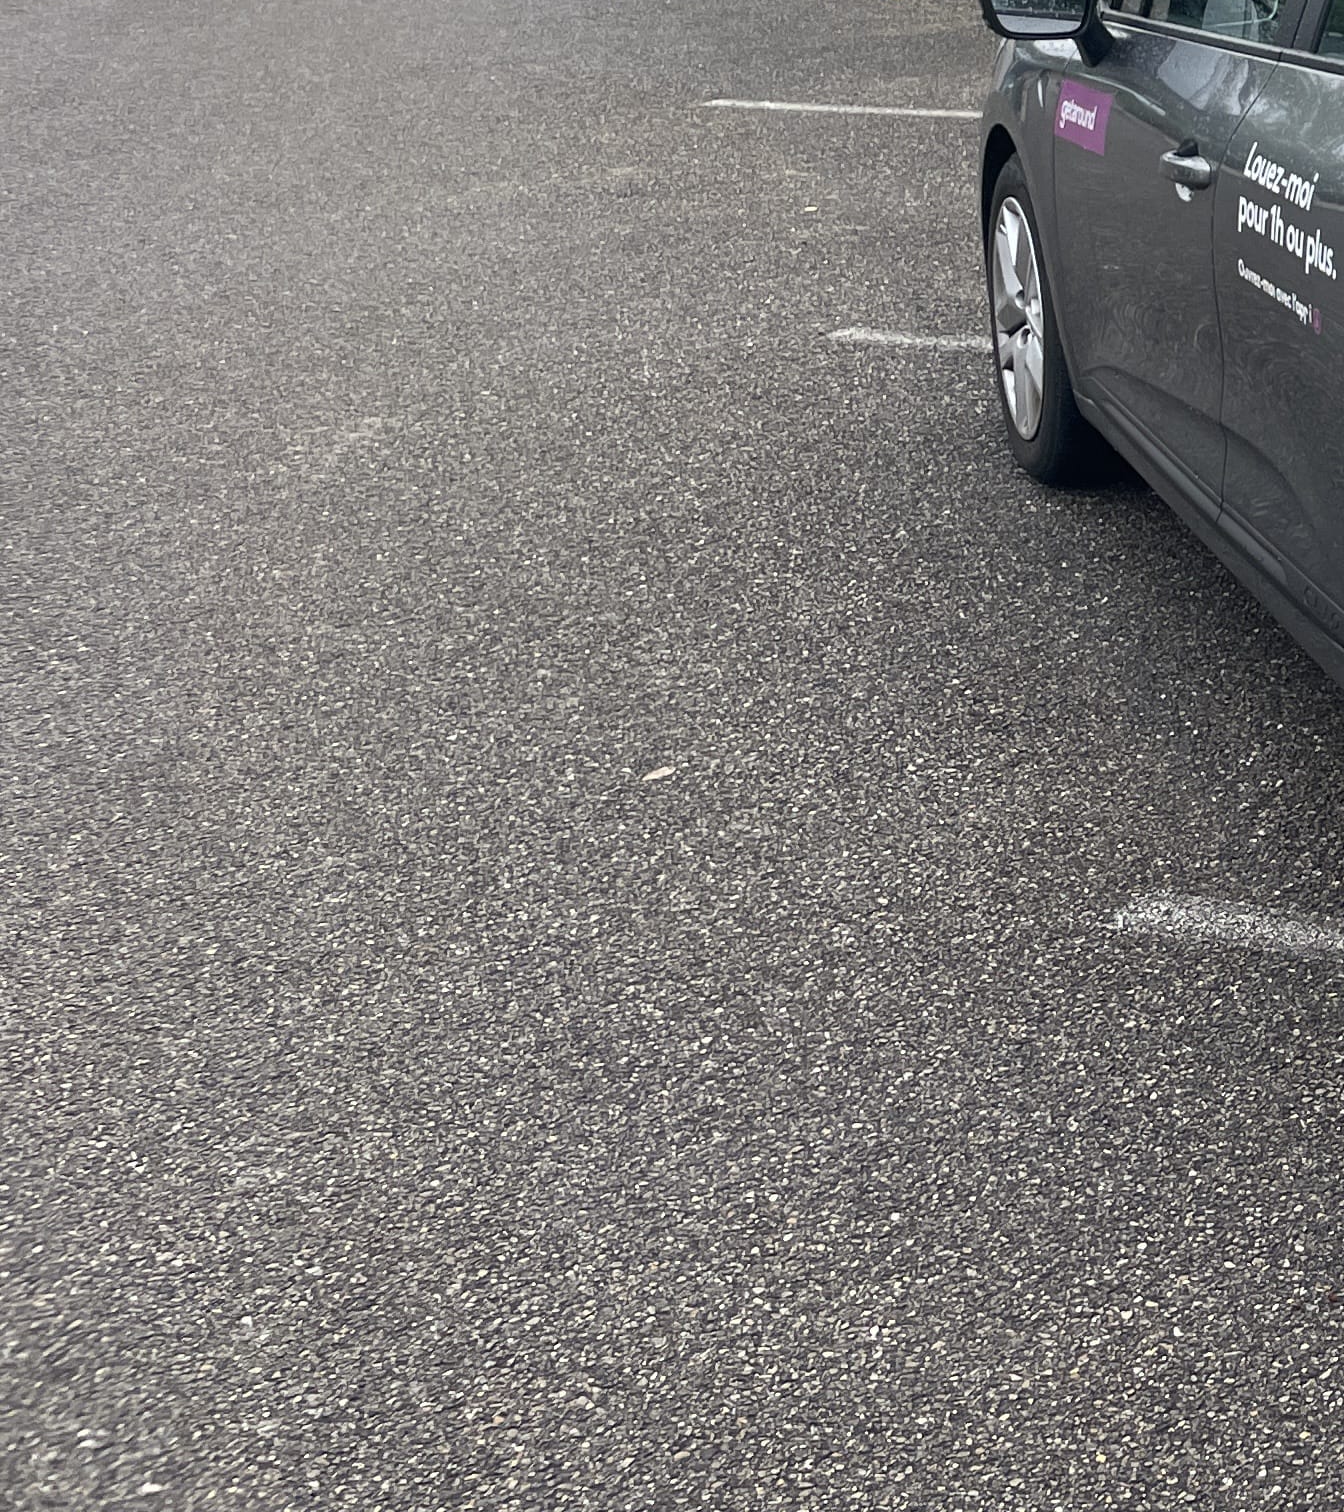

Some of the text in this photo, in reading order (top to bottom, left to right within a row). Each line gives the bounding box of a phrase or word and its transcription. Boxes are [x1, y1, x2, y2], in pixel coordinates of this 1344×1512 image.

[1243, 140, 1320, 212] Louez-moi
[1237, 195, 1337, 281] pour 1h ou plus.
